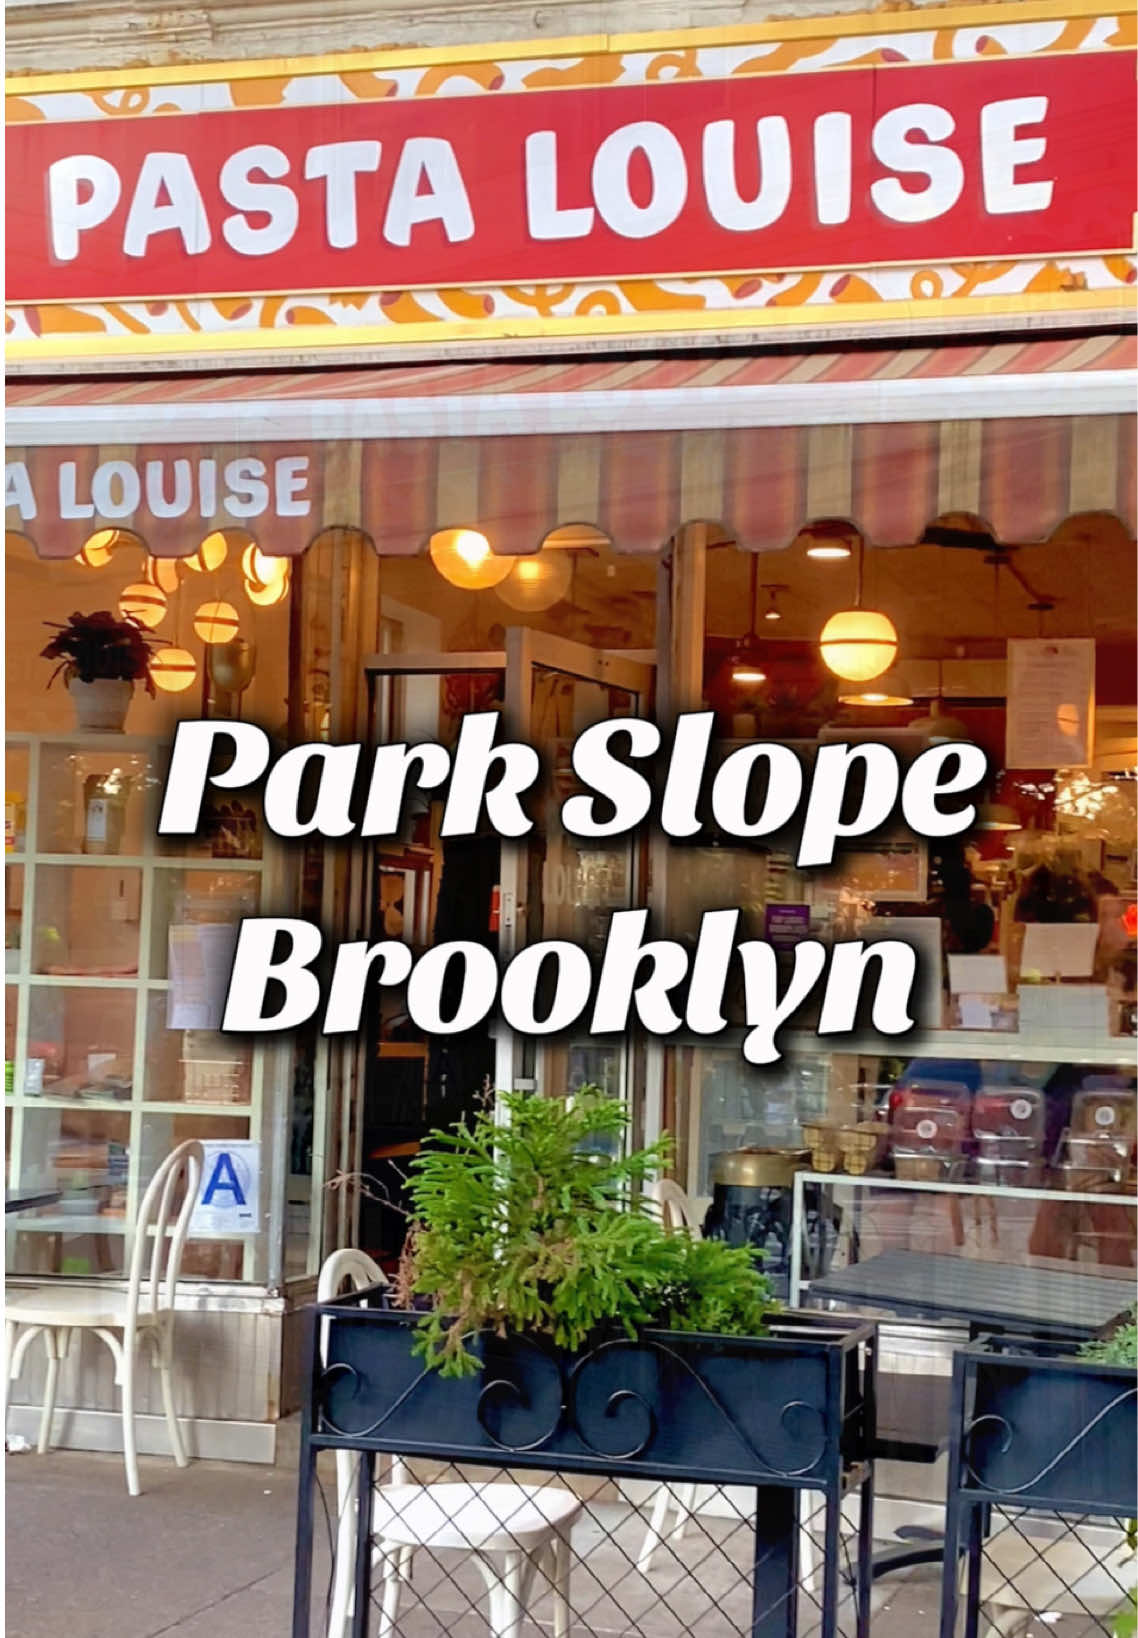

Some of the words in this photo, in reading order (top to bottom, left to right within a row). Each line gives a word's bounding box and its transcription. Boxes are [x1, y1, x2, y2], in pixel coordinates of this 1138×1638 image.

[49, 137, 475, 261] PASTA
[525, 96, 1054, 240] LOUISE
[59, 456, 311, 520] LOUISE
[201, 1152, 246, 1206] A
